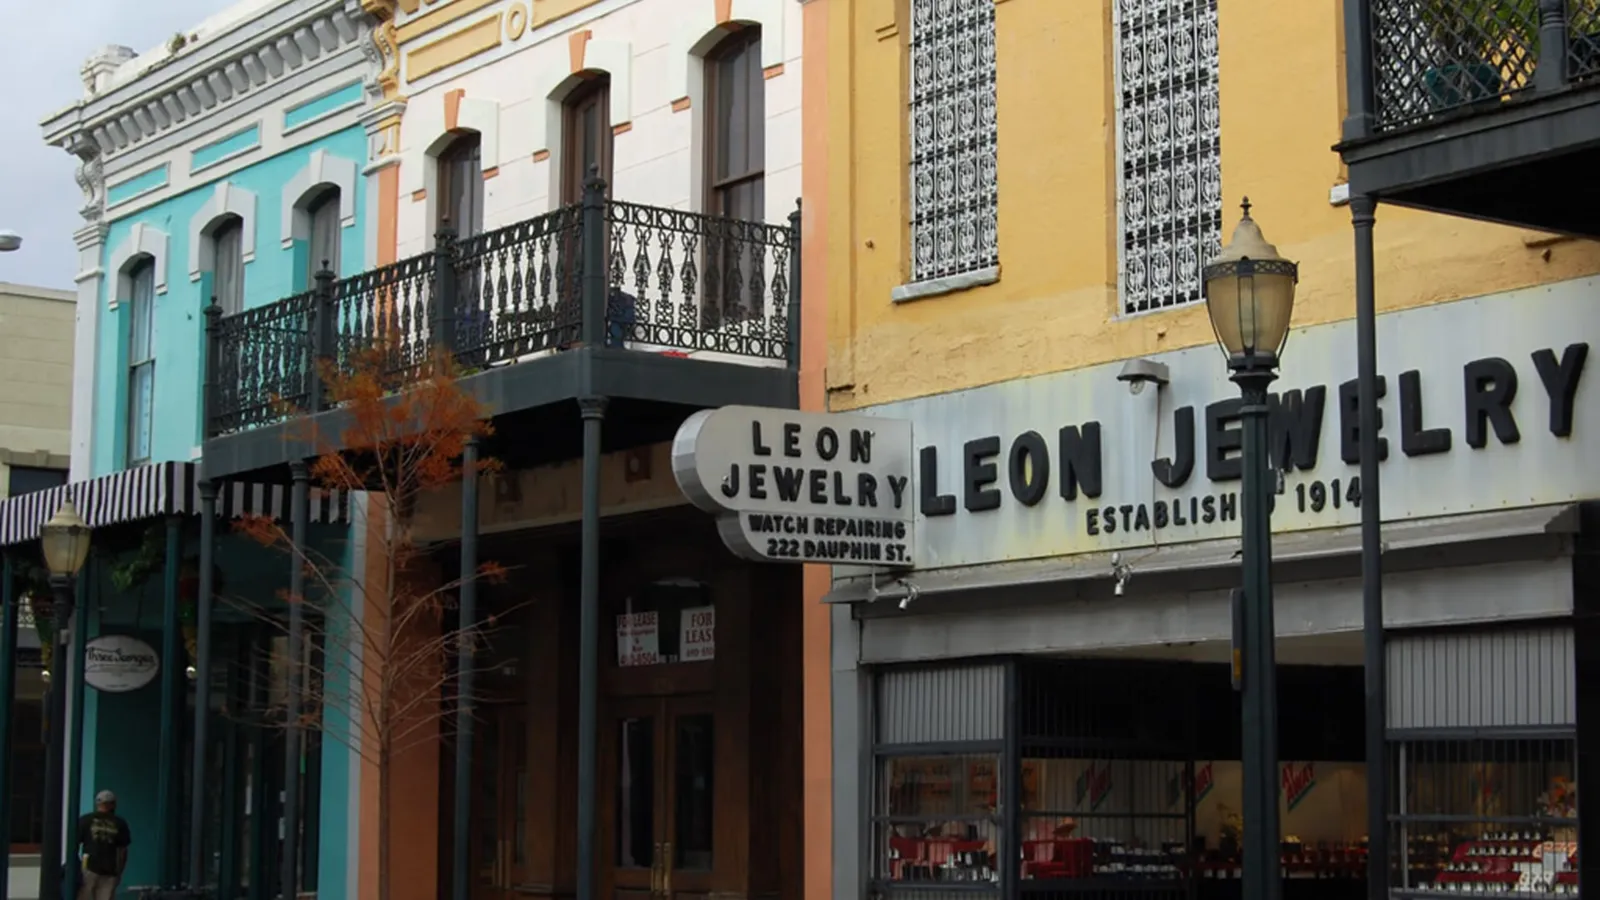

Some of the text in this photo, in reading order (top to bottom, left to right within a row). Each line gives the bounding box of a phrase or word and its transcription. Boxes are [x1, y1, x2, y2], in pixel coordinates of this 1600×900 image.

[752, 420, 873, 464] LEON
[920, 342, 1589, 516] LEON JEWELRY
[721, 463, 908, 509] JEWELRY
[1086, 475, 1362, 536] ESTABLISH 1914
[748, 514, 906, 540] WATCH REPAIRING
[766, 538, 912, 563] 222 DAUPHIN ST.
[691, 611, 713, 628] FOR
